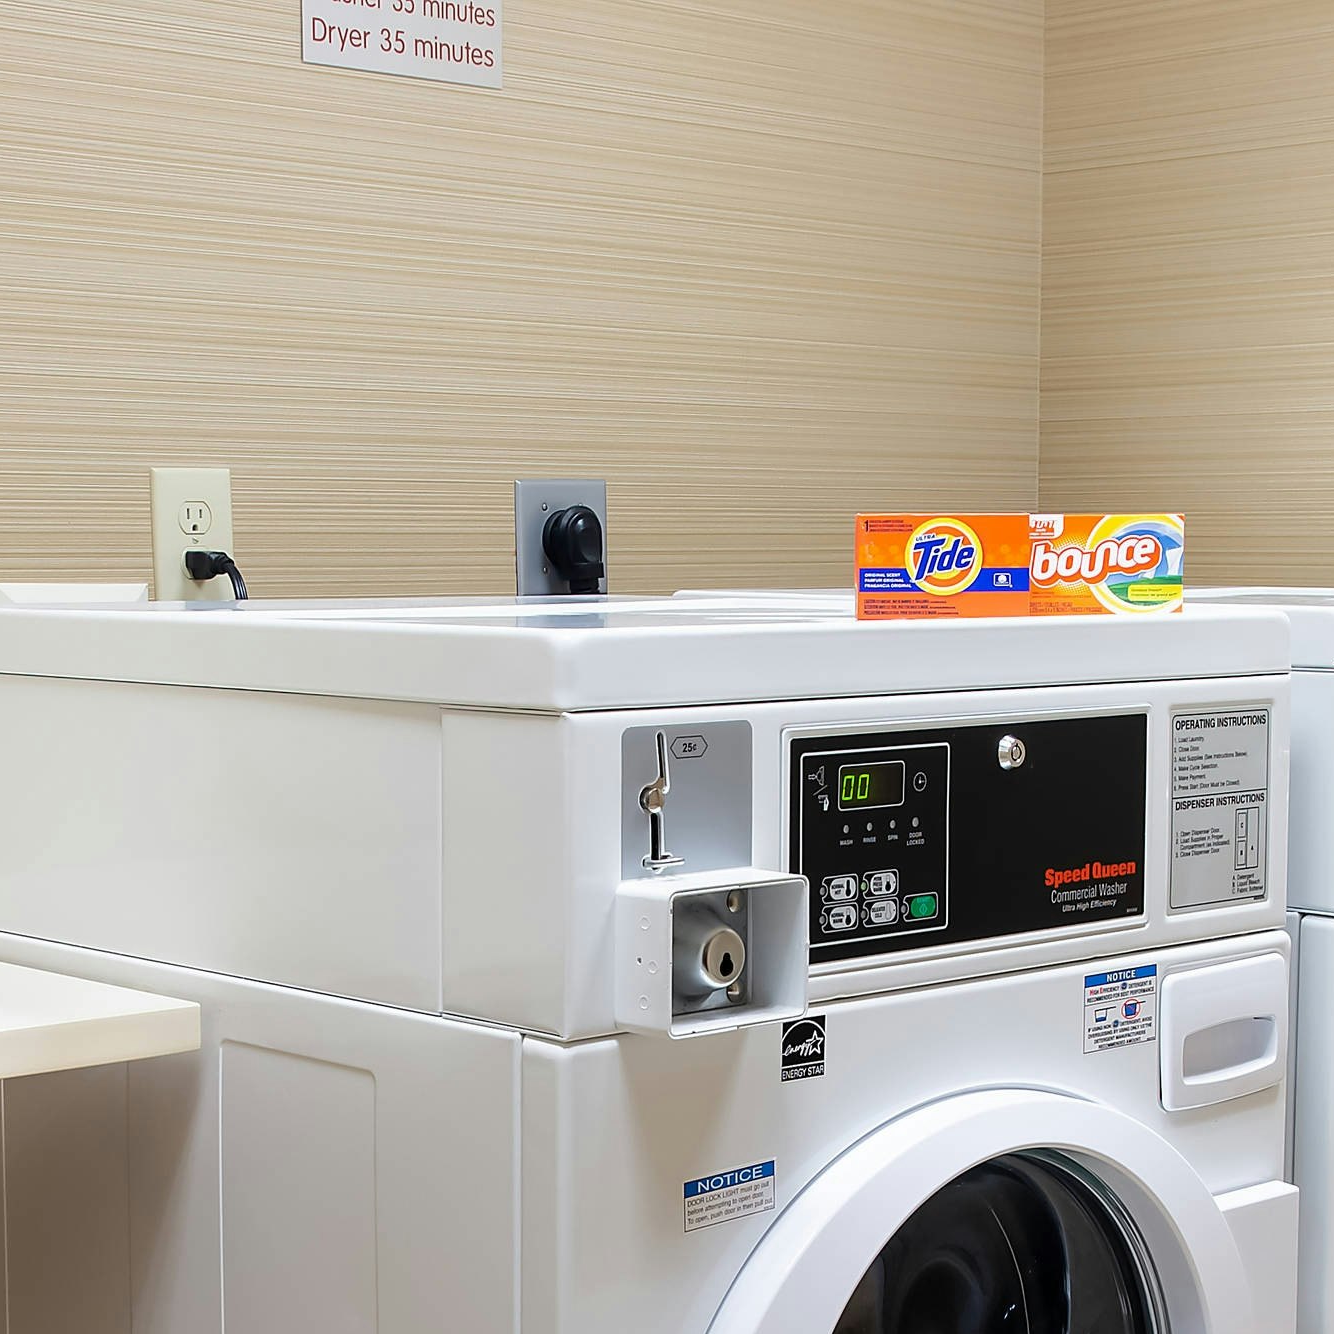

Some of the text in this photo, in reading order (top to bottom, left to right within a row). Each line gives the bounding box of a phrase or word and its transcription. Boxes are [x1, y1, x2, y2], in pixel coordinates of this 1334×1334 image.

[423, 0, 495, 27] minutes
[312, 17, 494, 67] Dryer 35 minutes
[913, 538, 975, 581] Tide
[1031, 536, 1160, 584] bounce
[1176, 715, 1266, 730] OPERATING INSTRUCTIONS
[842, 774, 869, 800] 00
[1176, 792, 1264, 811] DISPENSER INSTRUCTIONS
[1045, 861, 1136, 888] Speed Queen
[1051, 882, 1127, 903] Commercial Washer
[1062, 899, 1117, 912] Ultra High Efficiency
[1107, 970, 1136, 982] NOTICE
[782, 1064, 824, 1080] ENERGY STAR
[698, 1166, 763, 1193] NOTICE
